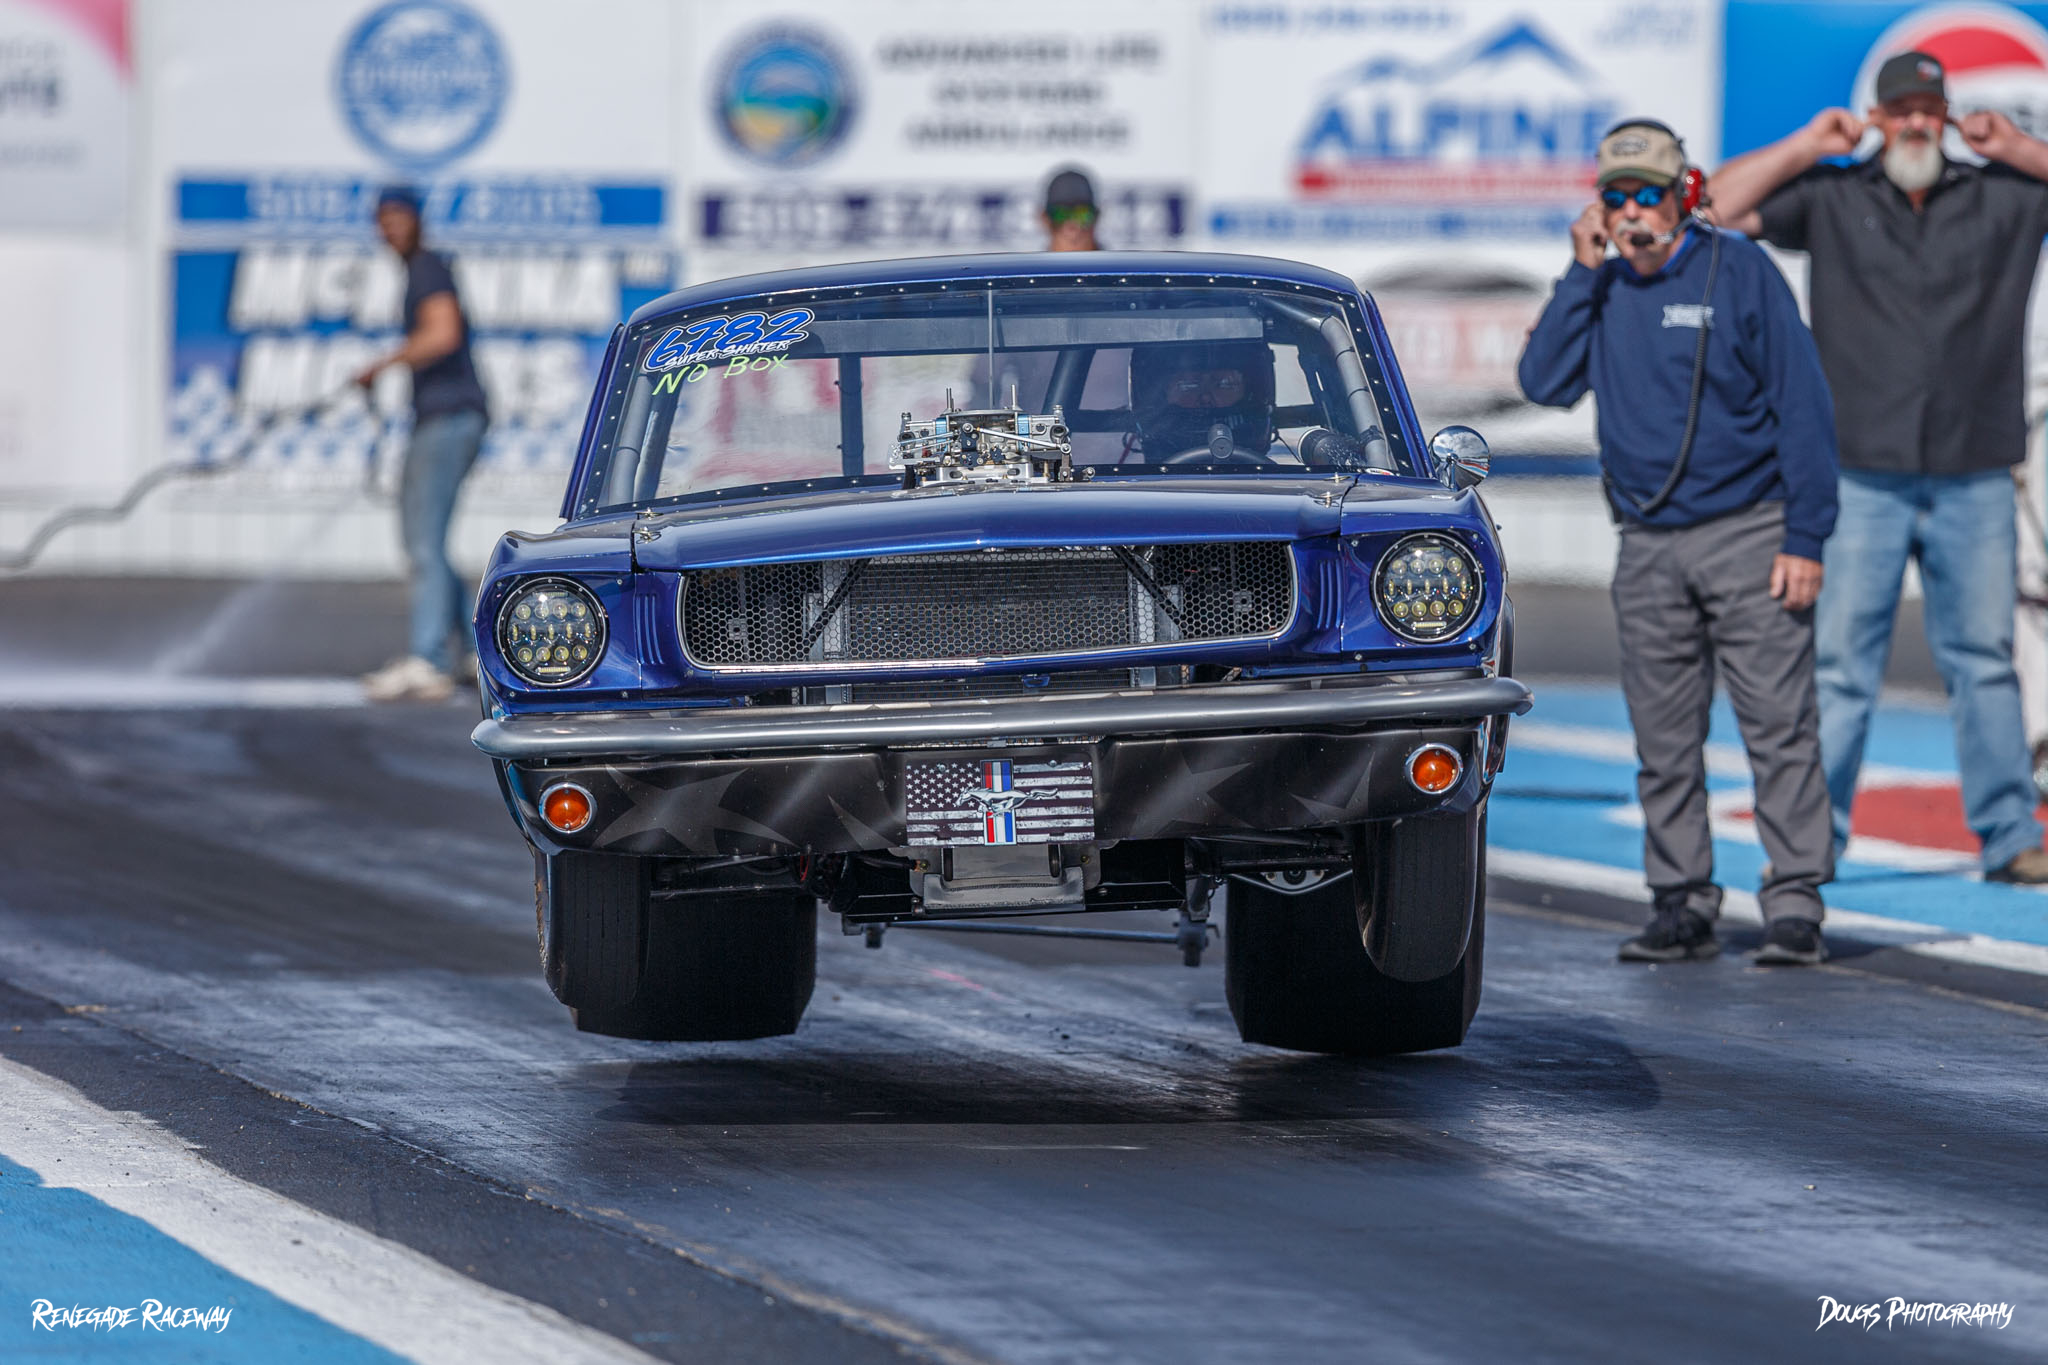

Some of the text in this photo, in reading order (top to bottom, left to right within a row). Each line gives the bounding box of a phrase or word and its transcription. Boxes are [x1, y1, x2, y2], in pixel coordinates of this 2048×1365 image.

[1298, 98, 1622, 158] ALPINE
[646, 309, 813, 370] 6782
[664, 340, 791, 367] SUPER SHIFTER
[652, 354, 789, 395] NO BOX
